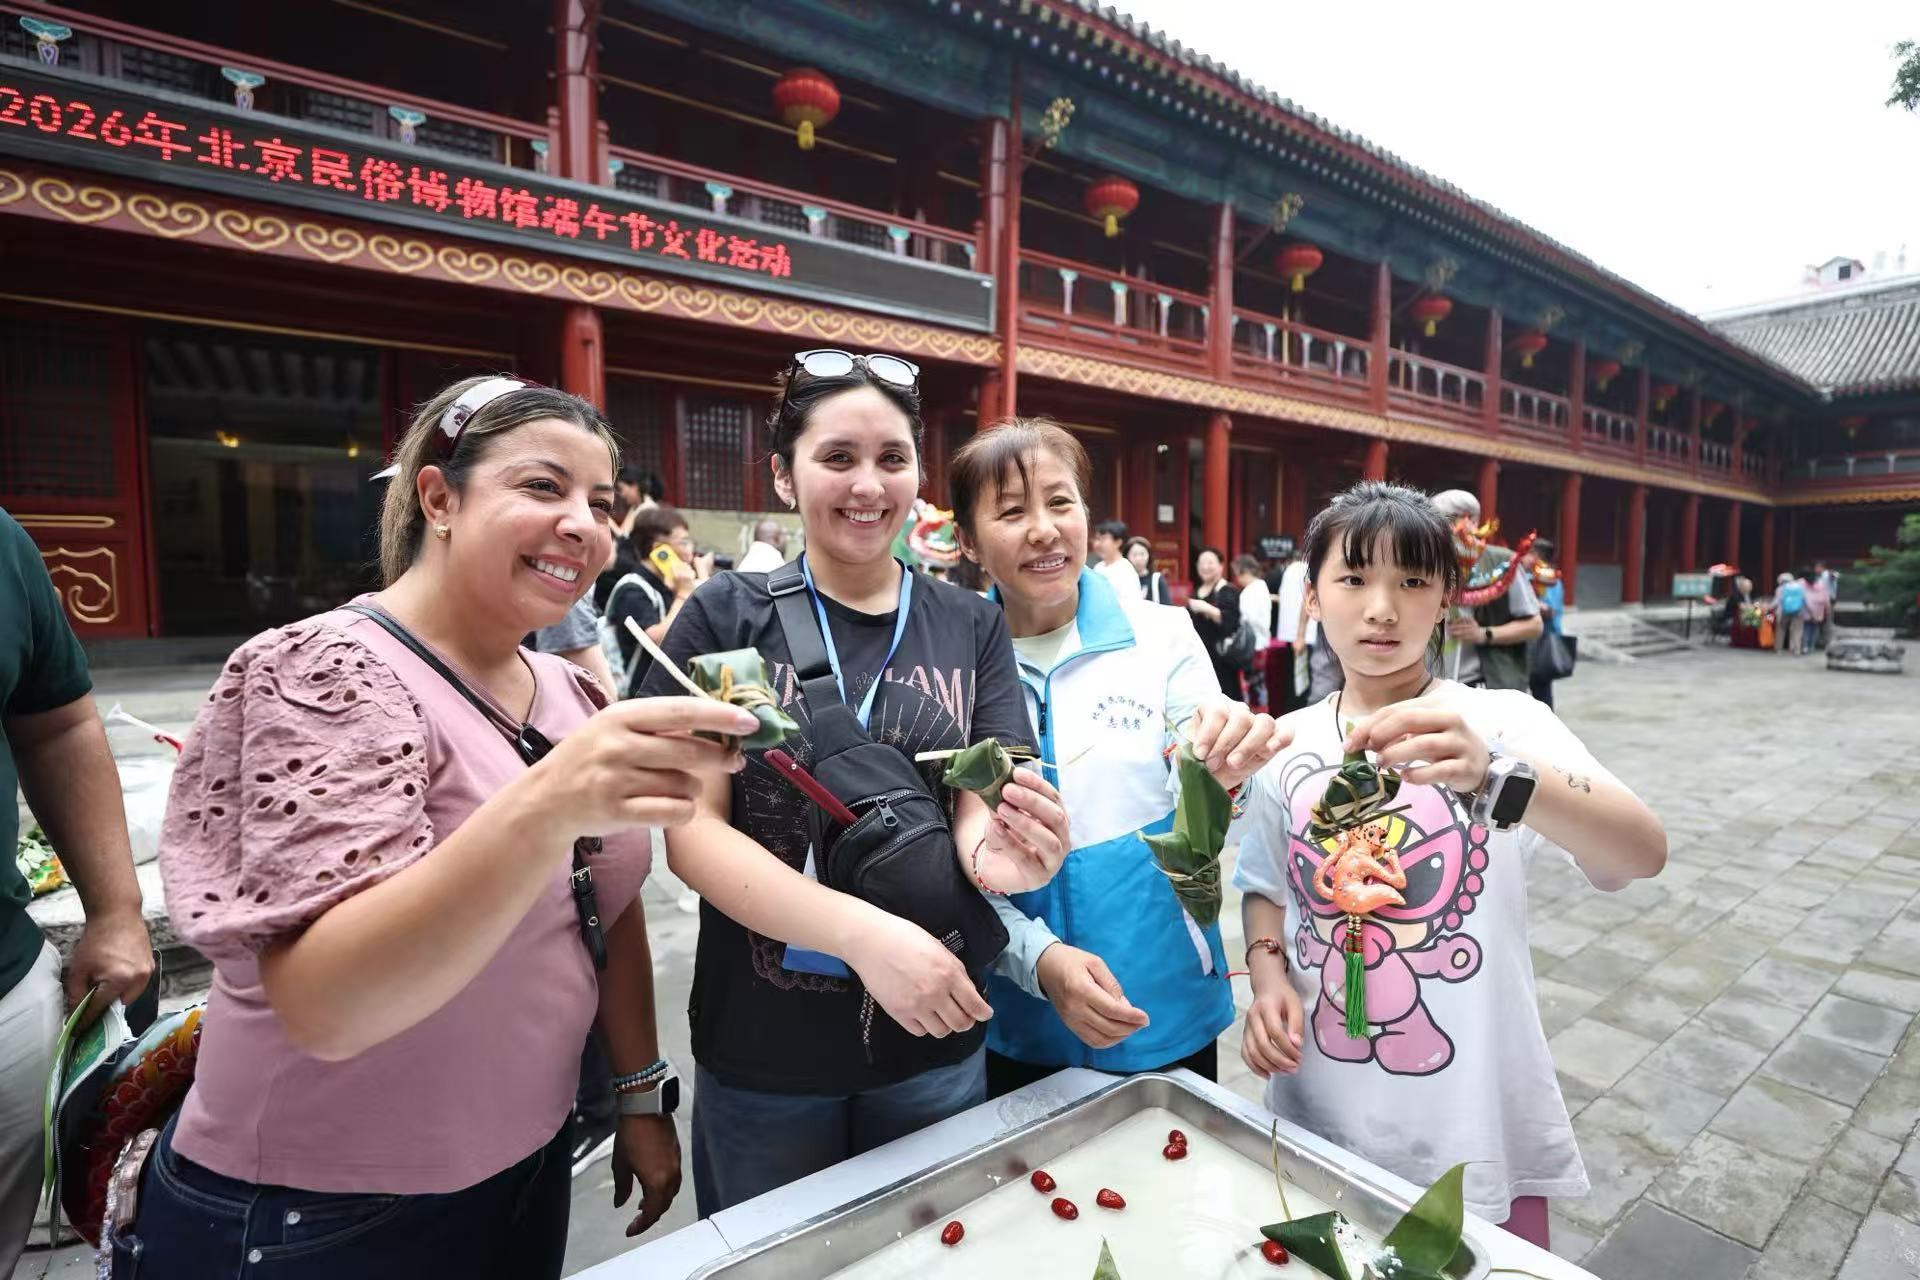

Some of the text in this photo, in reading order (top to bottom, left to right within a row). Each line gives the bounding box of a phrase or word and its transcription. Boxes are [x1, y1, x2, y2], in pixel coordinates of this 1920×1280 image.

[0, 86, 791, 278] 2026年北京民俗博物馆端午节文化活动
